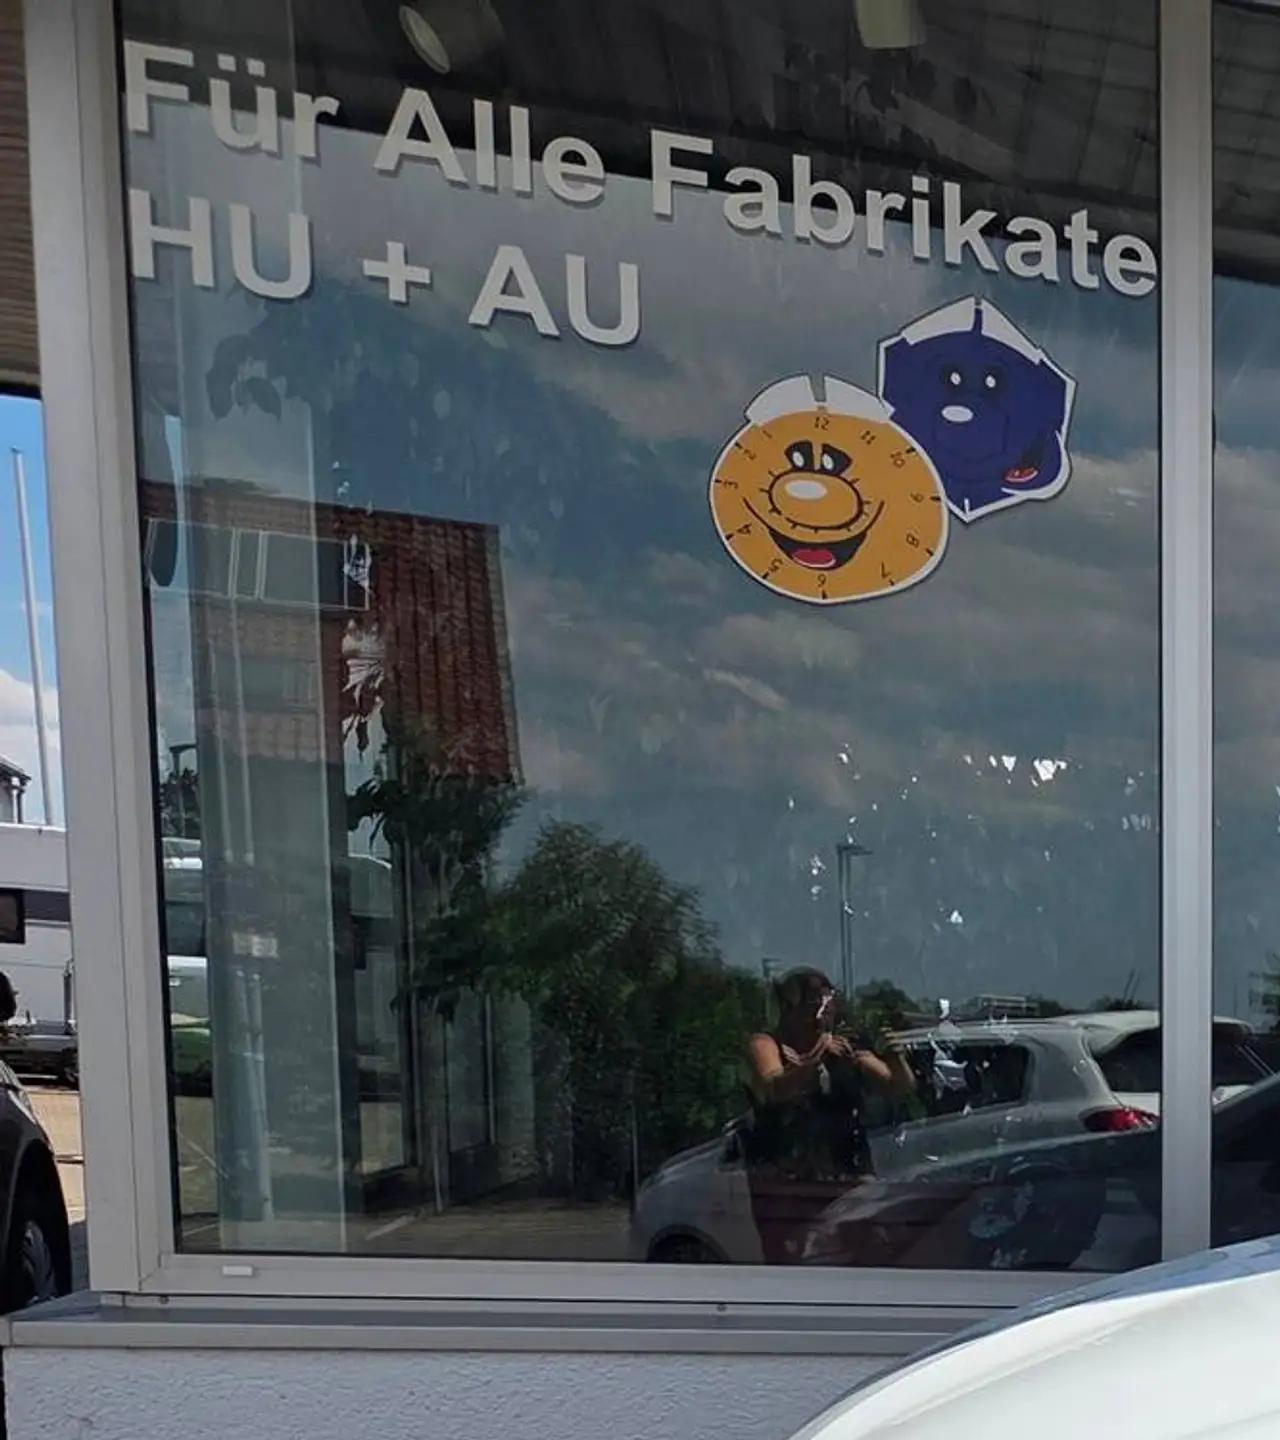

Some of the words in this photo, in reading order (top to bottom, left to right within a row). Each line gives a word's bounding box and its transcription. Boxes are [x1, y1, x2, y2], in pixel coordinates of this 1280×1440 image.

[124, 40, 338, 158] Für
[375, 86, 605, 202] Alle
[649, 128, 1160, 297] Fabrikate
[129, 187, 312, 300] HU
[468, 244, 641, 345] AU
